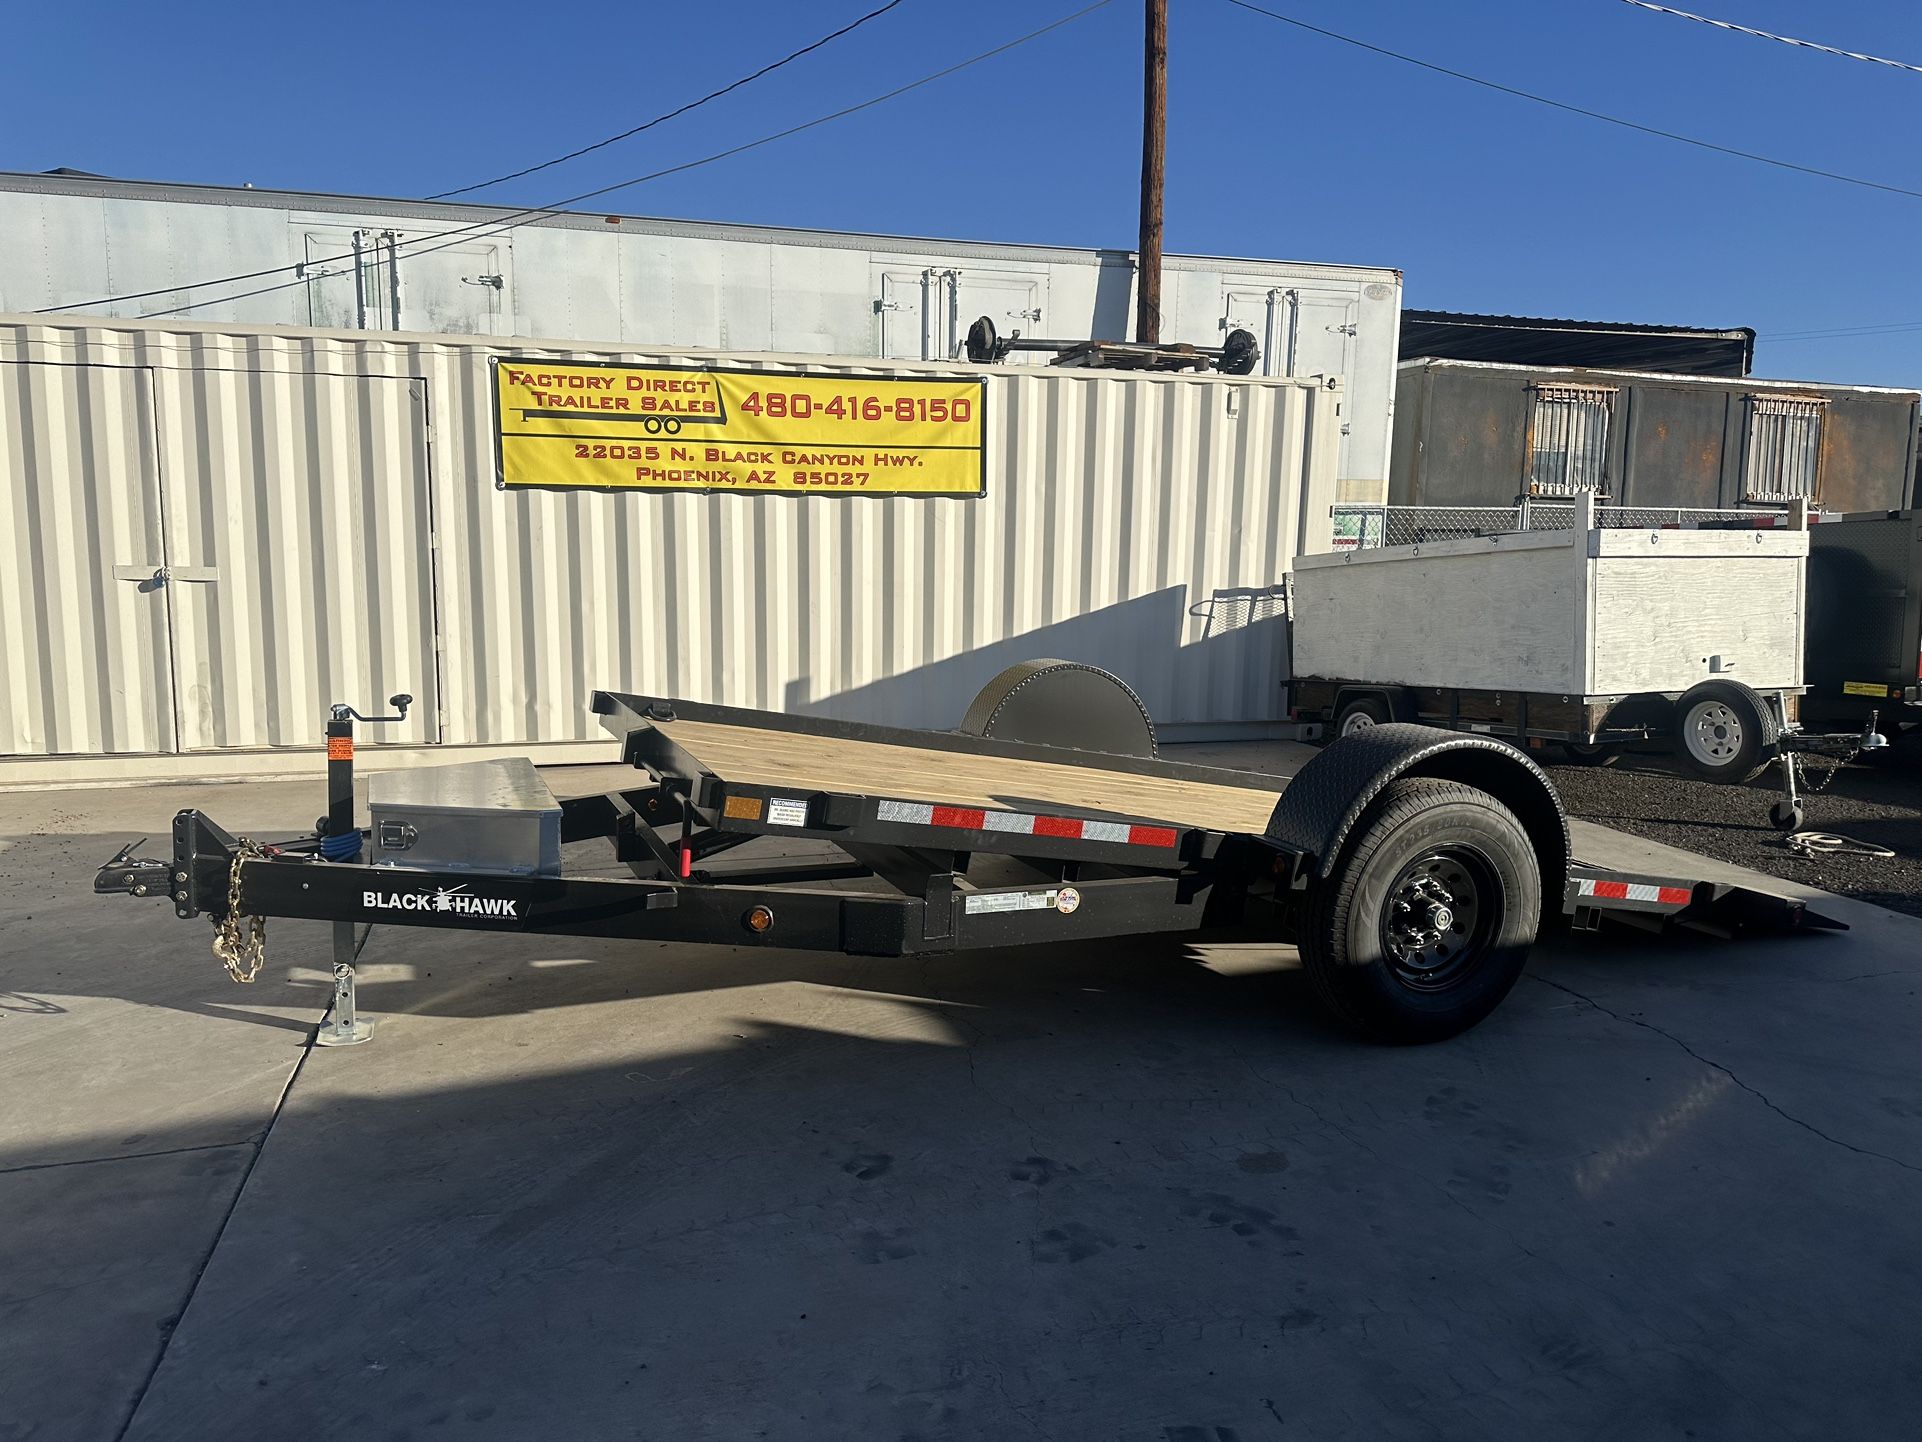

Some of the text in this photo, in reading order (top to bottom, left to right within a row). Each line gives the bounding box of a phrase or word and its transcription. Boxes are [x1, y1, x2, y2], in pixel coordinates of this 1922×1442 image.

[508, 370, 711, 394] FACTORY DIRECT
[531, 390, 716, 413] TRAILER SALES
[740, 391, 971, 422] 480-416-8150
[574, 444, 923, 467] 22035 N. BLACK CANYON HWY.
[636, 467, 870, 486] PHOENIX, AZ 85027
[363, 891, 517, 916] BLACK HAWK
